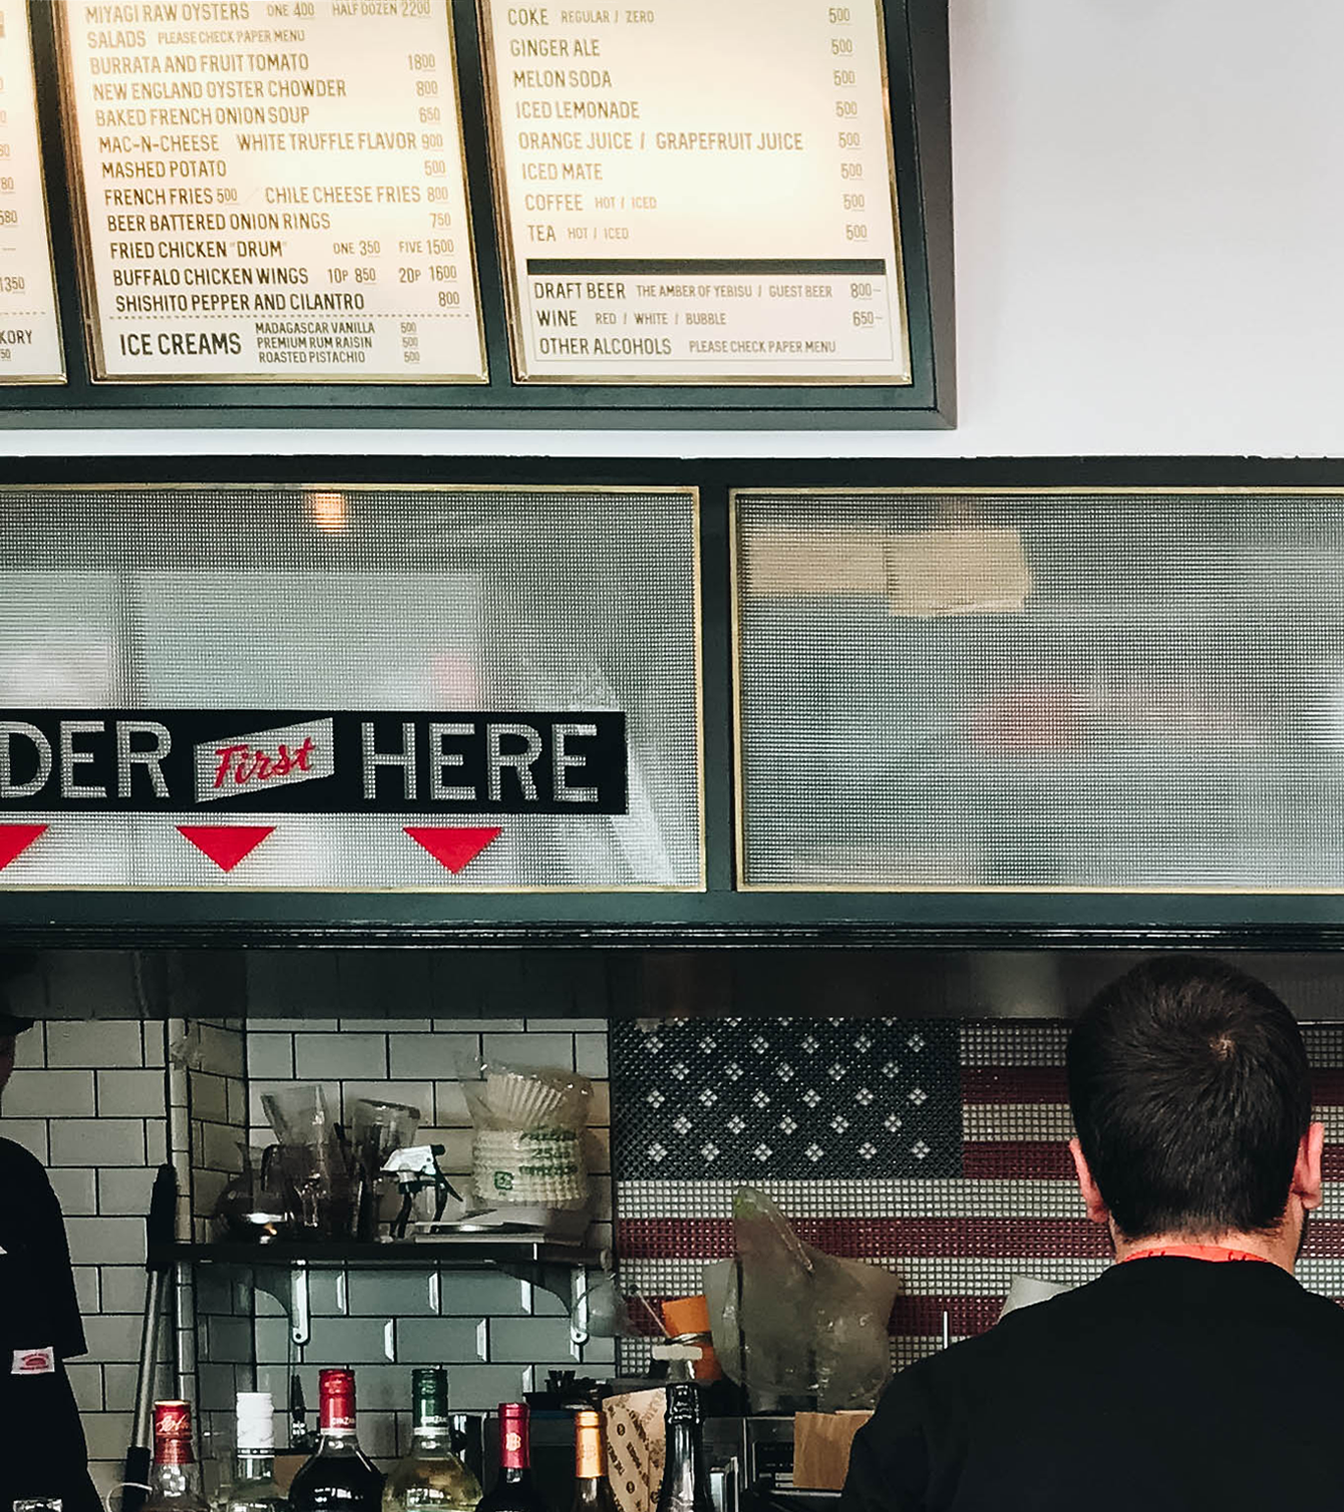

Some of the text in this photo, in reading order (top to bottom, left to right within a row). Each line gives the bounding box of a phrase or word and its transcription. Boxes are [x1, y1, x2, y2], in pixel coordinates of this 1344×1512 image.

[85, 5, 139, 24] MIYAGI
[143, 4, 178, 22] RAW
[181, 3, 249, 21] OYSTERS
[332, 3, 359, 16] HALF
[361, 1, 398, 16] DOZEN
[402, 0, 431, 17] 2200
[508, 7, 851, 26] COKE REGULAR ZERO 500
[87, 29, 305, 48] SALADS PLEASE CHECK PAPER MENU
[510, 38, 853, 57] GINGER ALE 500
[90, 53, 435, 75] BURRATA AND FRUIT TOMATO 1800
[513, 70, 856, 88] MELON SODA 500
[93, 79, 438, 101] NEW ENGLAND OYSTER CHOWDER 800
[96, 109, 146, 127] BAKED
[150, 107, 212, 126] FRENCH
[216, 107, 265, 125] ONION
[268, 106, 310, 124] SOUP
[516, 101, 858, 119] ICED LEMONADE 500
[99, 132, 443, 153] MAC-N-CHEESE WHITE TRUFFLE FLAVOR 900
[519, 132, 861, 150] ORANGE JUICE GRAPEFRUIT JUICE 500
[102, 160, 446, 178] MASHED POTATO 500
[521, 163, 862, 180] ICED MATE 500
[104, 185, 449, 206] FRENCH FRIES 500 CHILE CHEESE FRIES 800
[525, 194, 584, 212] COFFEE
[843, 194, 865, 210] 500
[107, 212, 451, 232] BEER BATTERED ONION RINGS 750
[528, 225, 556, 242] TEA
[845, 224, 867, 241] 500
[110, 242, 154, 259] FRIED
[158, 241, 227, 258] CHICKEN
[333, 242, 355, 255] ONE
[359, 240, 381, 257] 350
[399, 240, 423, 254] FIVE
[427, 239, 454, 256] 1500
[113, 268, 180, 286] BUFFALO
[184, 267, 252, 286] CHICKEN
[256, 267, 309, 285] WINGS
[354, 267, 376, 284] 850
[429, 265, 457, 282] 1600
[534, 282, 583, 299] DRAFT
[587, 282, 626, 299] BEER
[636, 285, 657, 298] THE
[659, 285, 696, 298] AMBER
[769, 285, 803, 298] GUEST
[805, 285, 833, 298] BEER
[116, 291, 460, 313] SHISHITO PEPPER AND CILANTRO 800
[255, 321, 375, 334] MADAGASCAR VANILLA
[536, 310, 726, 327] WINE RED WHITE BUBBLE
[120, 332, 242, 356] ICE CREAMS
[257, 336, 373, 349] PREMIUM RUM RAISIN
[540, 338, 836, 355] OTHER ALCOHOLS PLEASE CHECK PAPER MENU
[259, 351, 366, 364] ROASTED PISTACHIO
[0, 719, 600, 802] DER First HERE
